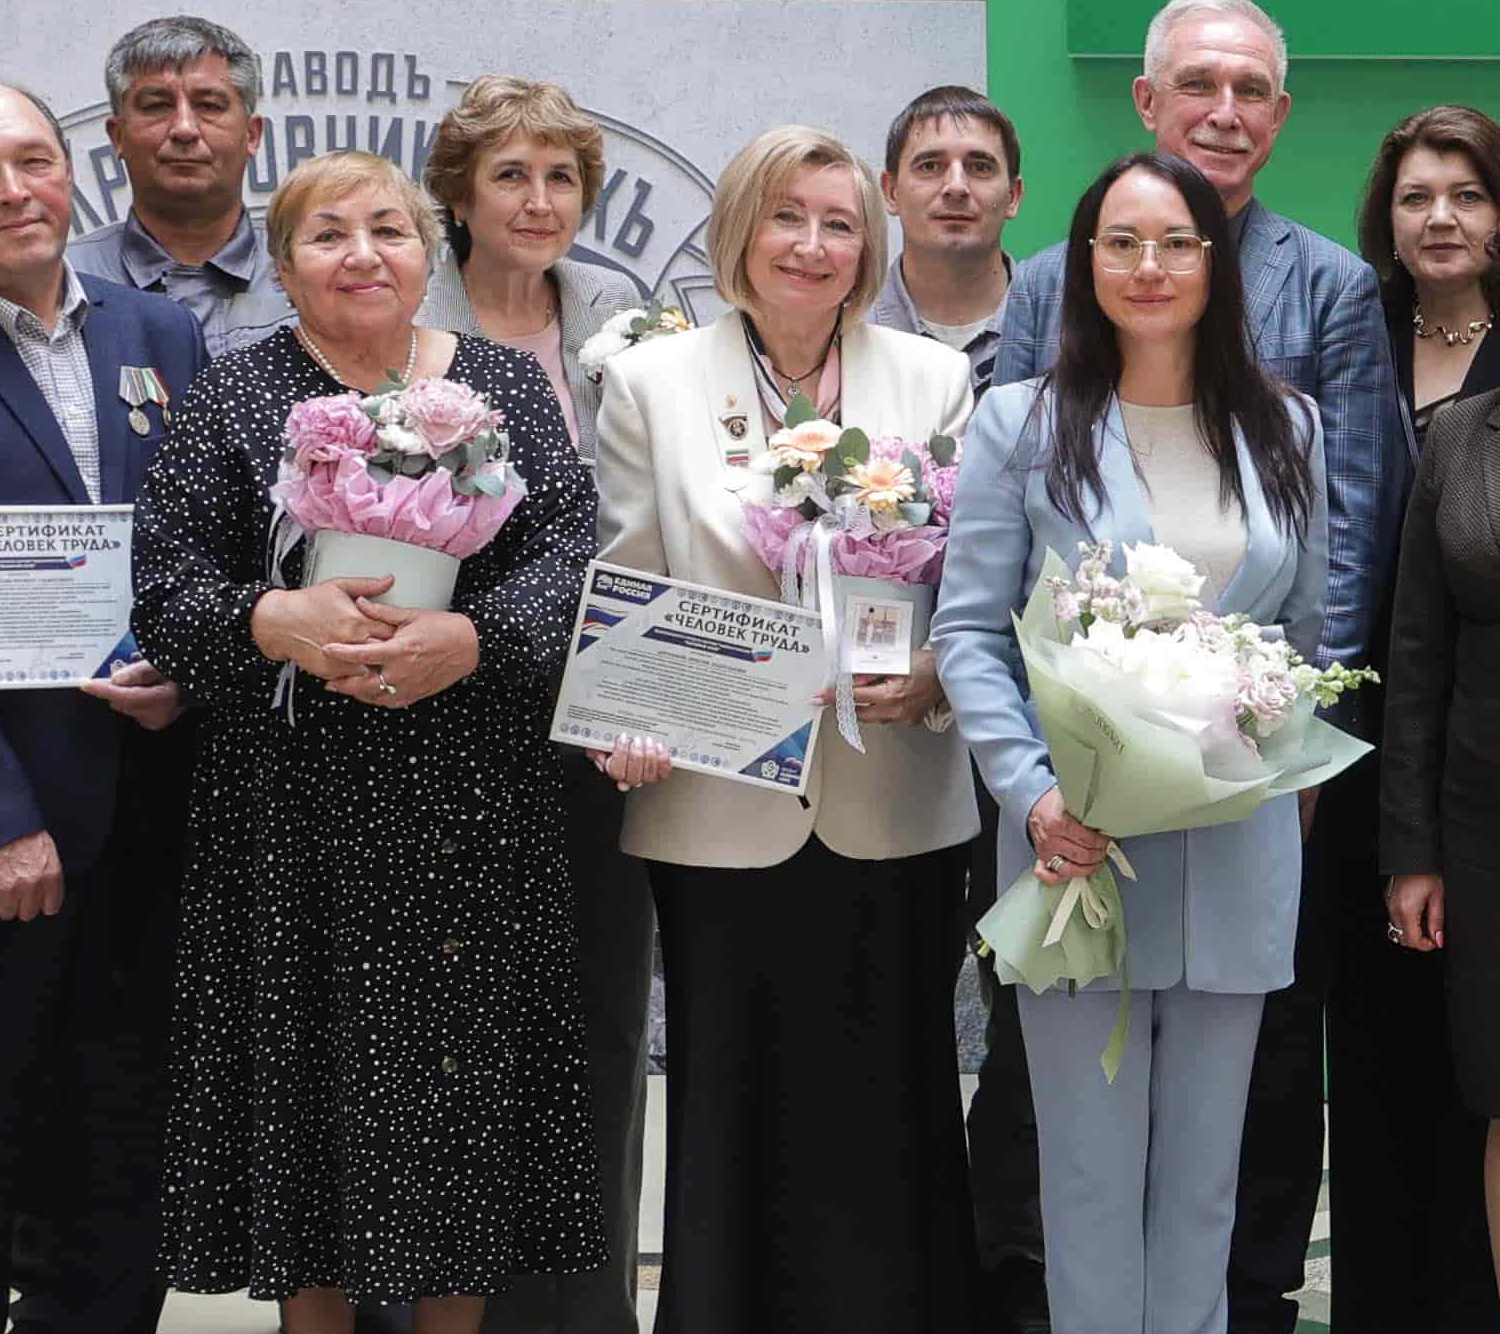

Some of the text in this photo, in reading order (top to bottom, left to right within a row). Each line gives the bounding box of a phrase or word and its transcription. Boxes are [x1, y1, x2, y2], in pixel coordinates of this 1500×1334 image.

[257, 51, 431, 105] АВОДЪ
[60, 538, 121, 552] ТРУДА»
[664, 612, 747, 641] «ЧЕЛОВЕК
[750, 631, 810, 654] ТРУДА»
[678, 600, 800, 637] СЕРТИФИКАТ
